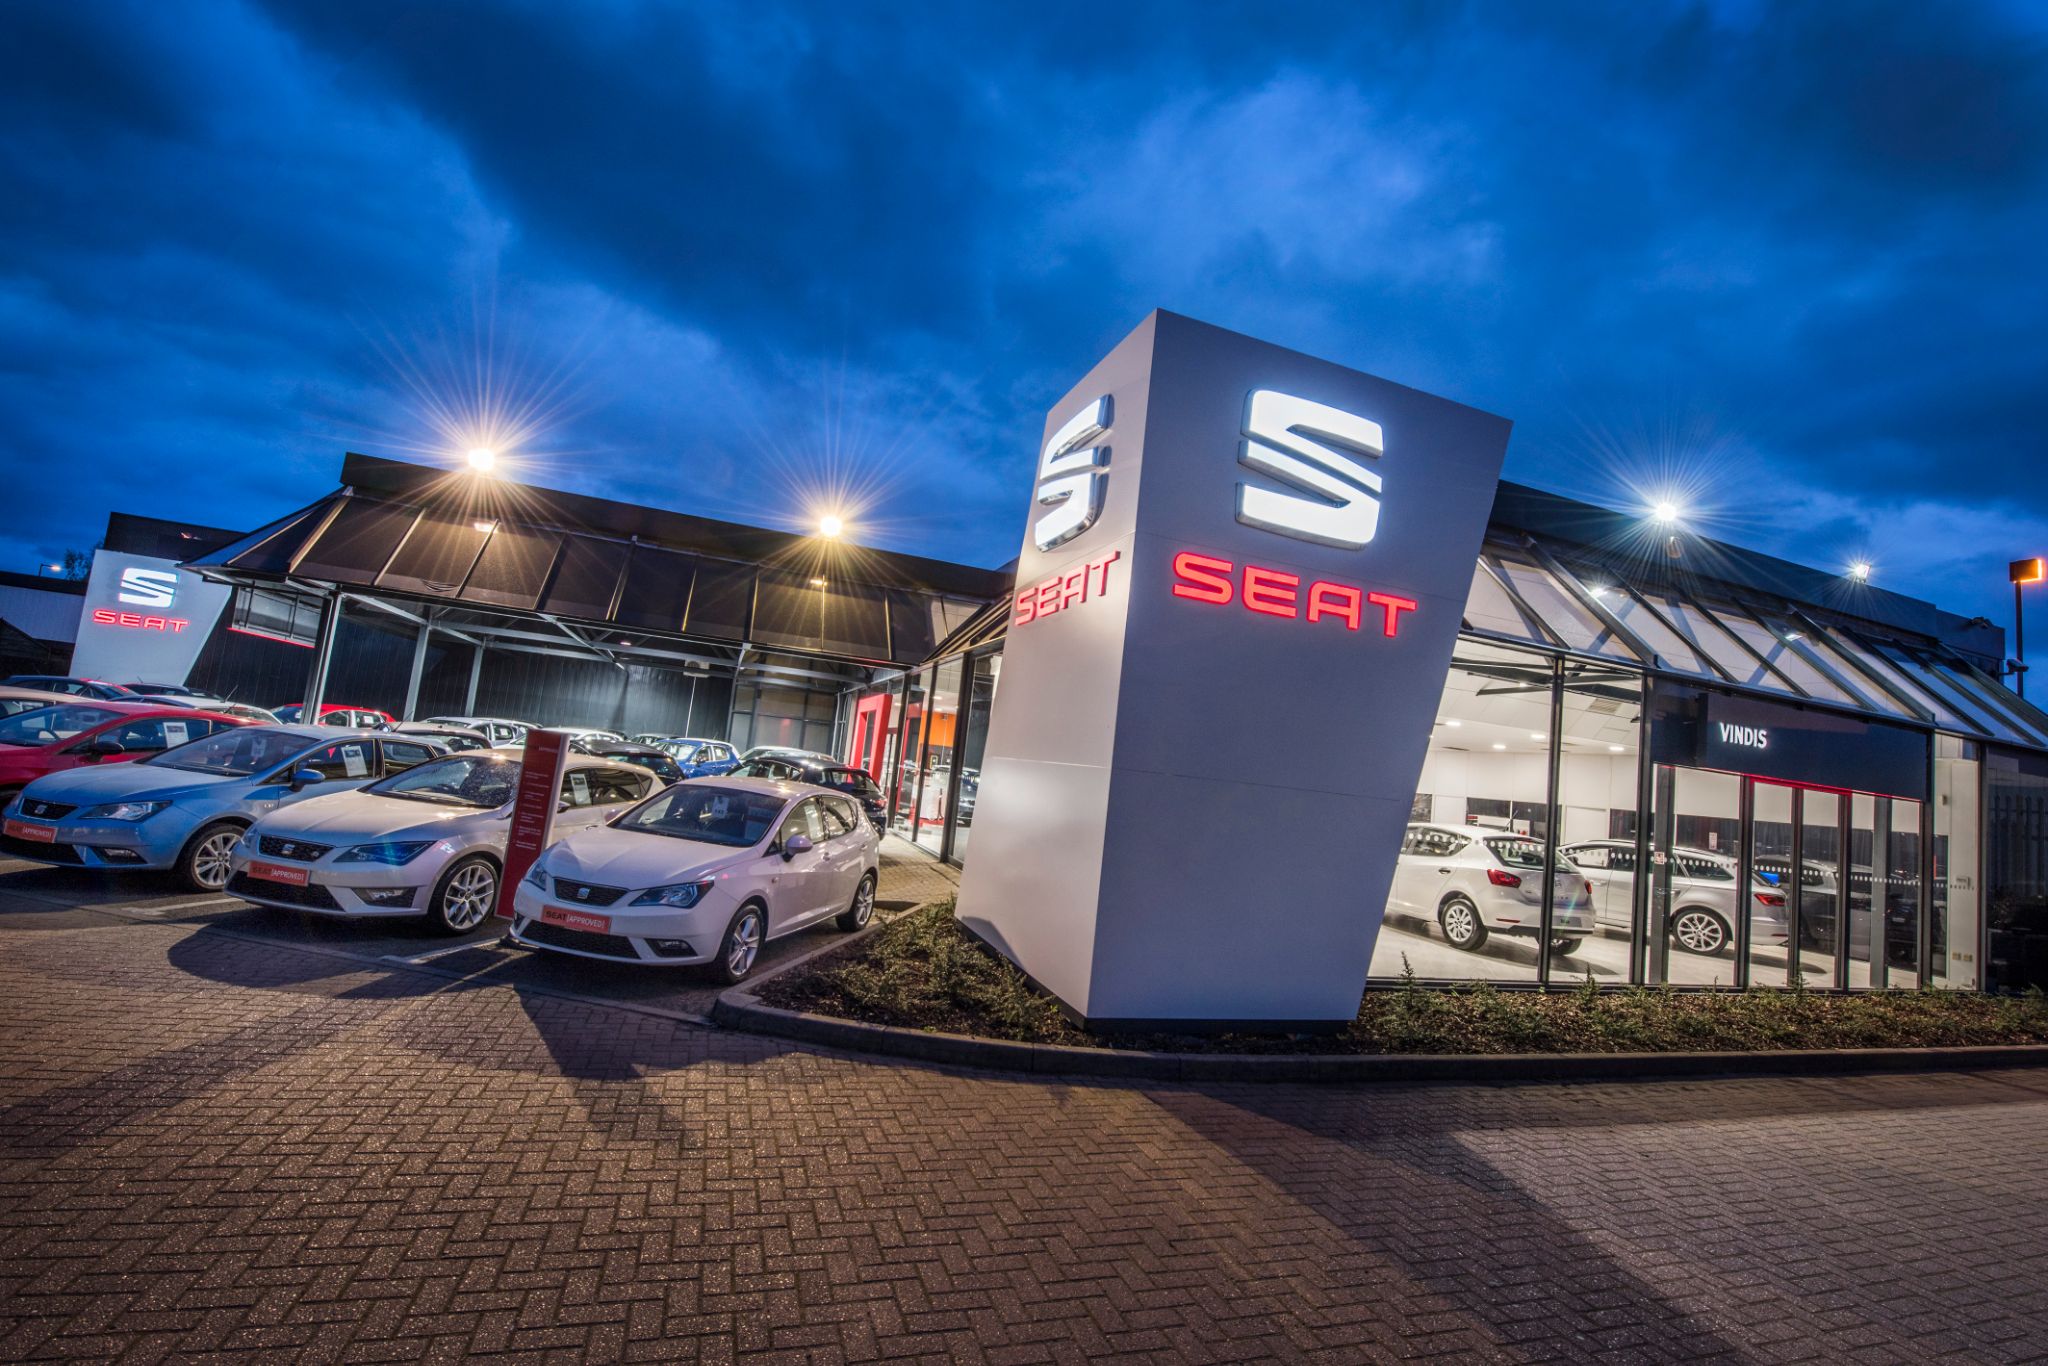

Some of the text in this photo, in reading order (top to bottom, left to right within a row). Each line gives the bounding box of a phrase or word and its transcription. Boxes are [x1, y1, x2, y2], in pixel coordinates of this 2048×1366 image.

[1015, 551, 1121, 626] SEAT
[1172, 551, 1417, 638] SEAT
[93, 609, 189, 633] SEAT
[1719, 721, 1768, 749] VINDIS
